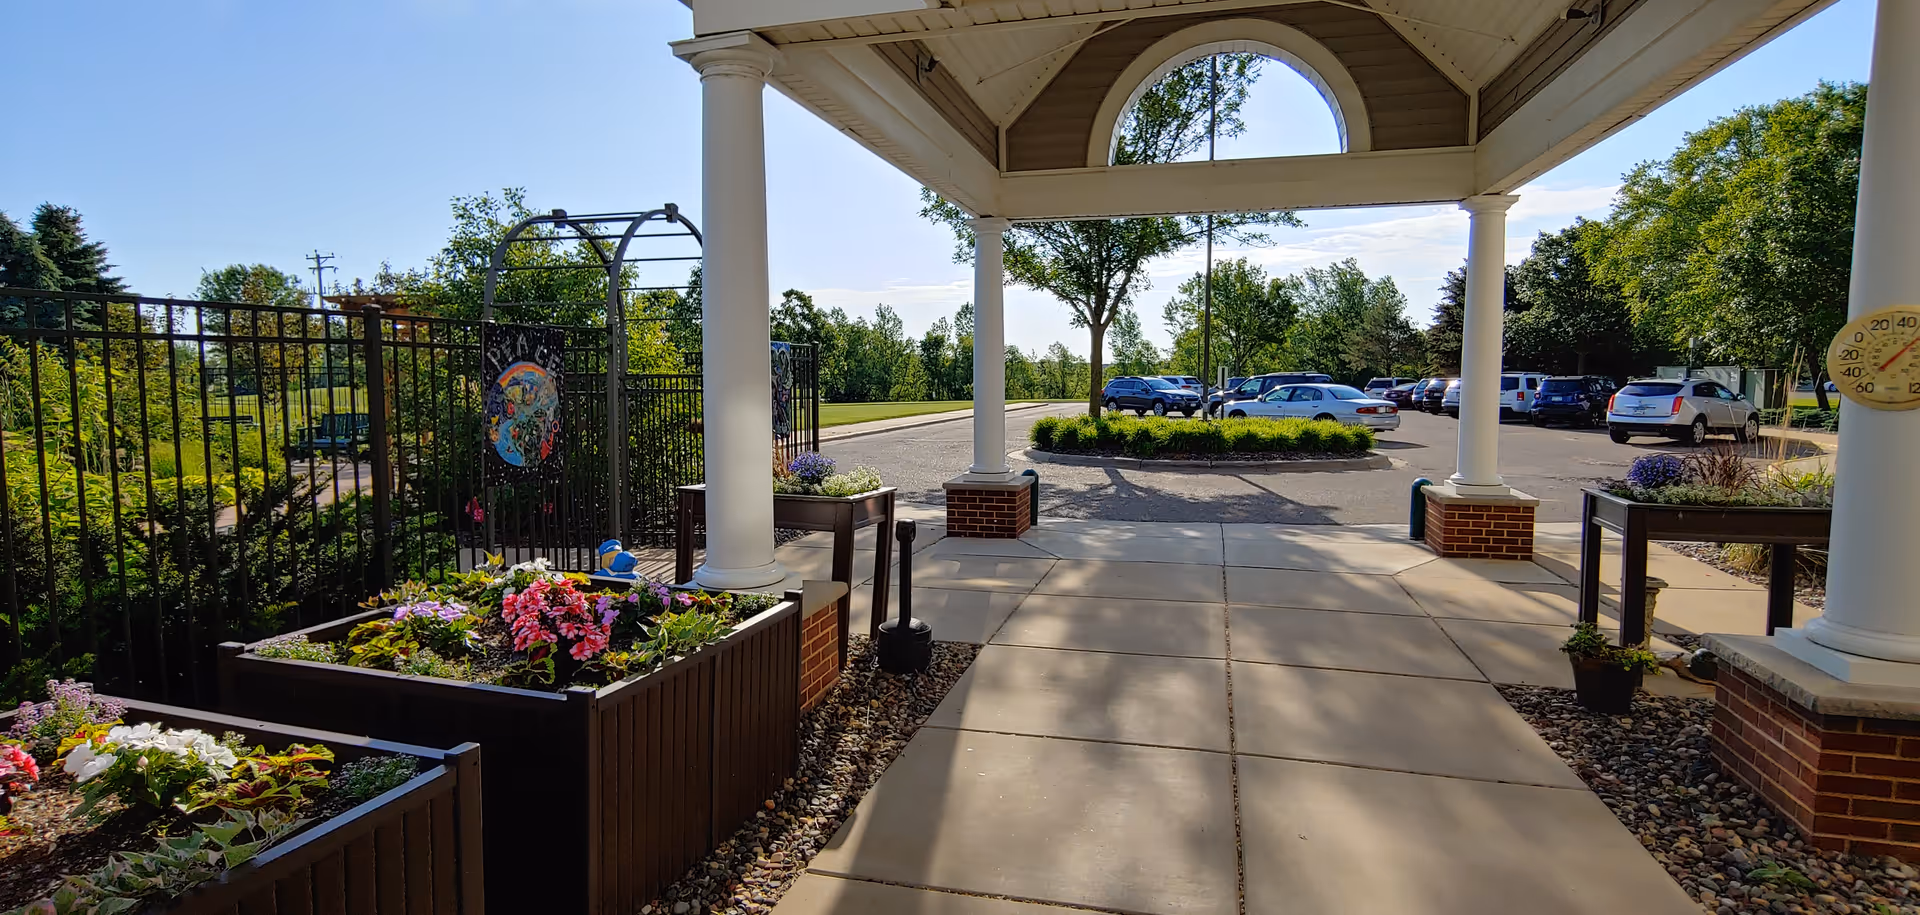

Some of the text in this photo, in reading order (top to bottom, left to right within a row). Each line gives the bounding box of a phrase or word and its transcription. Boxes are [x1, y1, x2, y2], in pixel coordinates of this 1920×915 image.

[1870, 319, 1889, 331] 20
[1896, 316, 1917, 328] 40
[1854, 331, 1864, 343] 0
[1838, 349, 1860, 361] -20
[1840, 366, 1862, 378] -40
[1852, 382, 1875, 394] -60
[1908, 382, 1920, 394] 12
